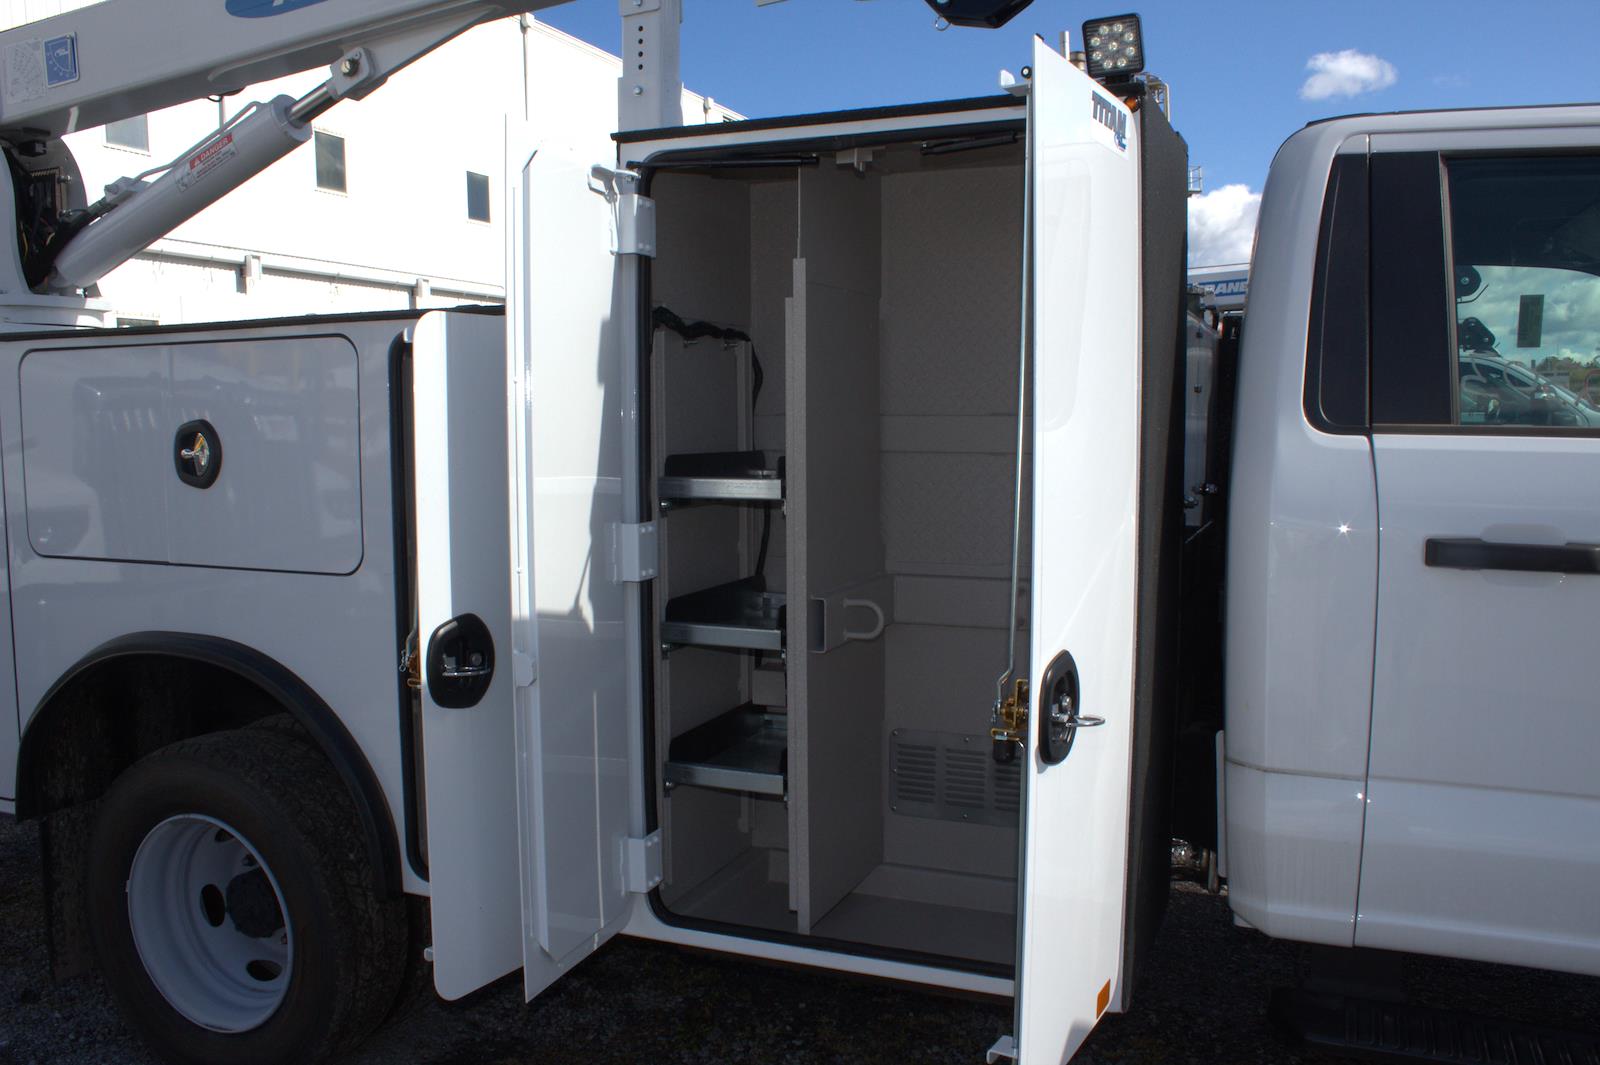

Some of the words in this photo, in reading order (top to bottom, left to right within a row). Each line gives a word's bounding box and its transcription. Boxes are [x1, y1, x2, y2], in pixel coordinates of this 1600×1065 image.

[1092, 90, 1127, 138] TITAN
[200, 137, 229, 161] DANGER
[1201, 281, 1248, 296] RANE
